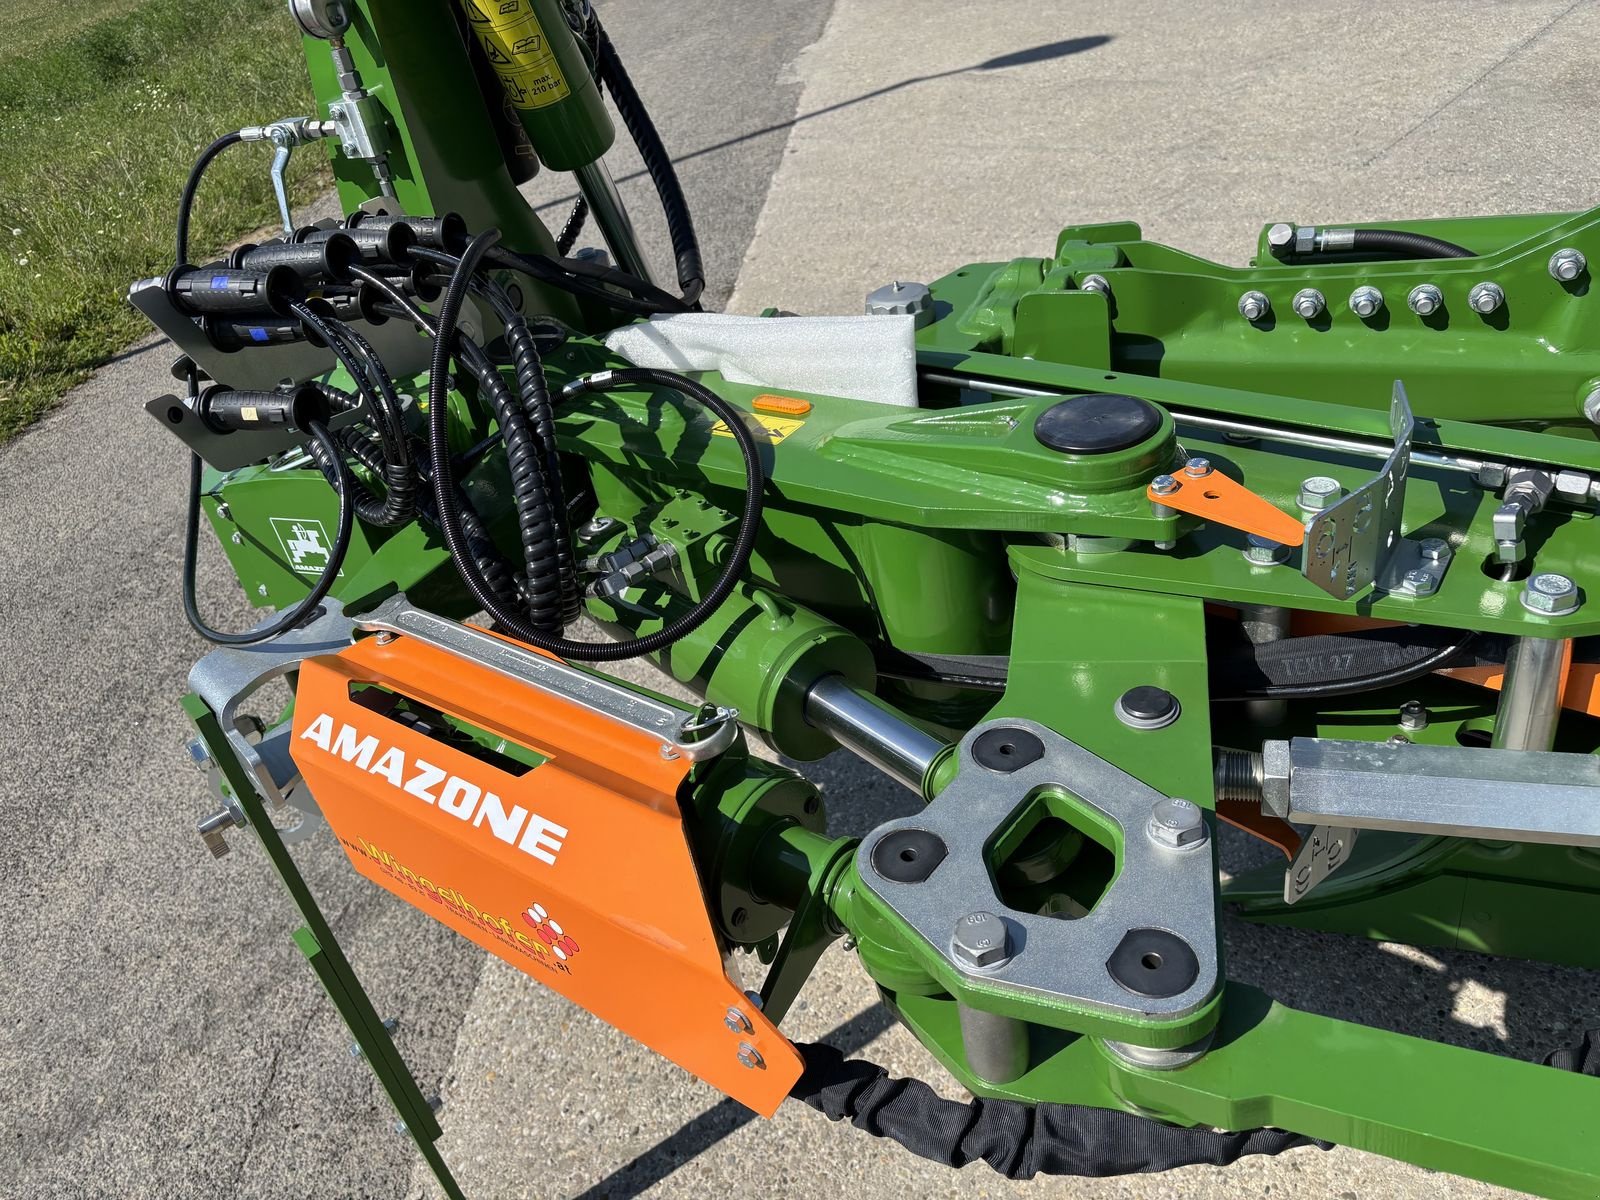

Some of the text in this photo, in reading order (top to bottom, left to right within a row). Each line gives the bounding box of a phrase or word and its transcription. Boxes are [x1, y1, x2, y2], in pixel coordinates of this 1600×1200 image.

[531, 79, 561, 96] 210 bar
[533, 74, 553, 85] max.
[300, 713, 568, 865] AMAZONE
